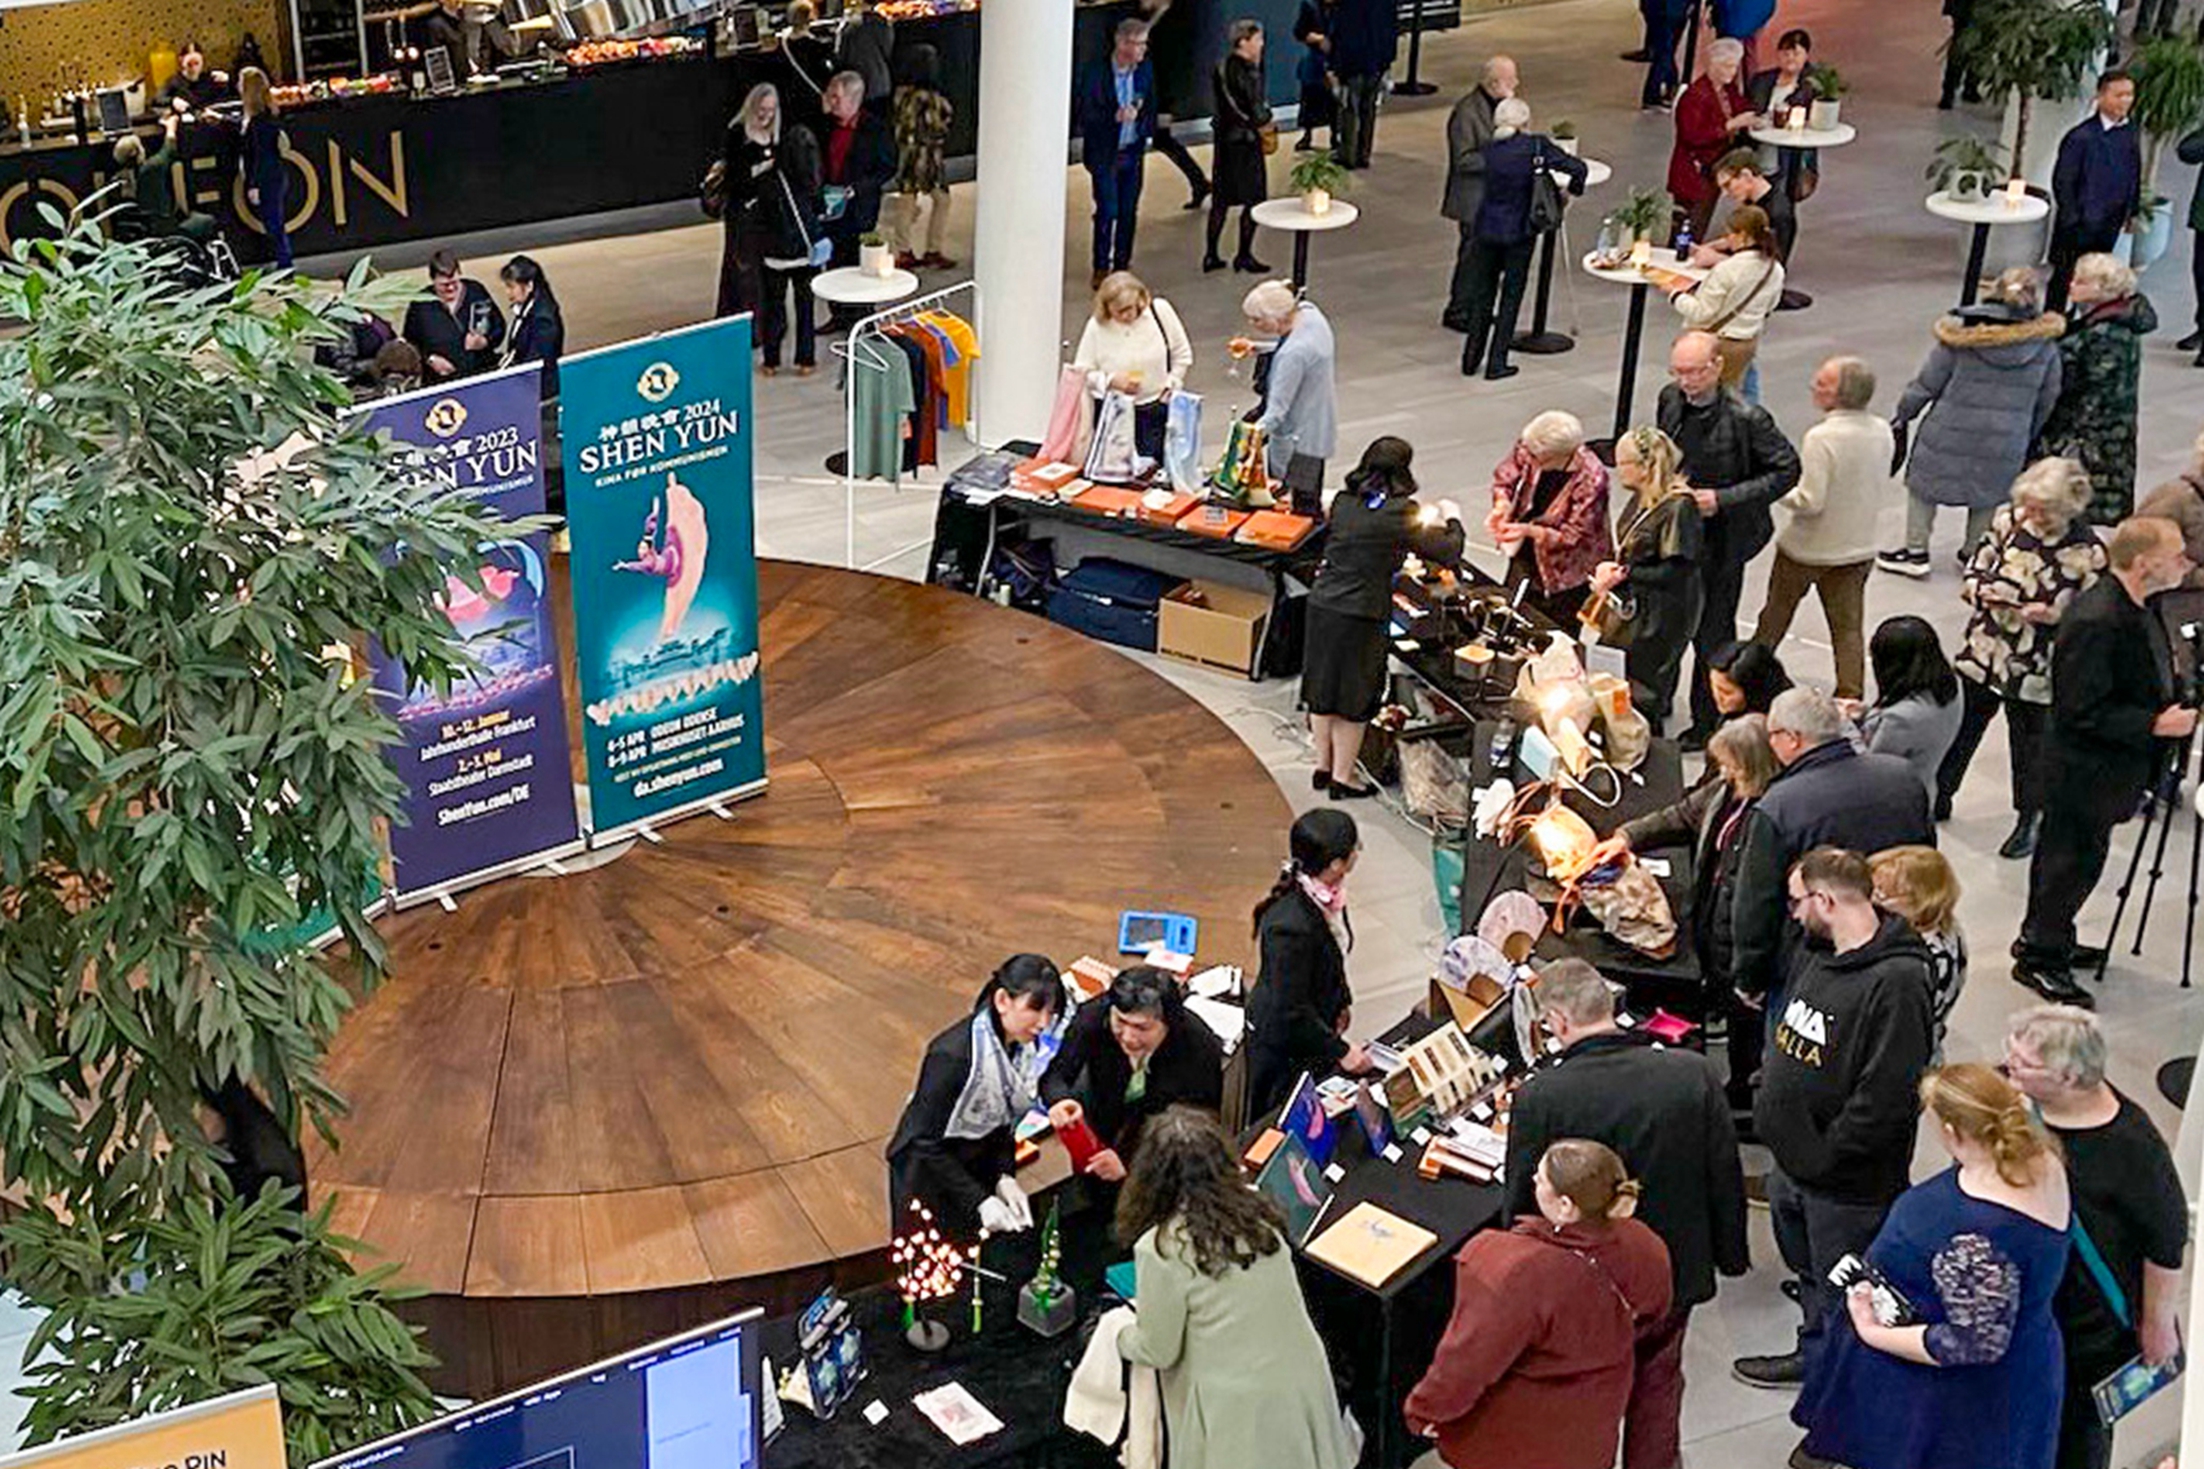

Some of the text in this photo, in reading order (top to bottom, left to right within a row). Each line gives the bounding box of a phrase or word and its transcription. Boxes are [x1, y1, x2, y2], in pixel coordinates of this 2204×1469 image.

[683, 398, 720, 421] 2024
[476, 427, 518, 452] 2023
[579, 410, 738, 473] SHEN YUN
[466, 440, 536, 482] YUN
[438, 783, 529, 826] ShenYun.com/DE
